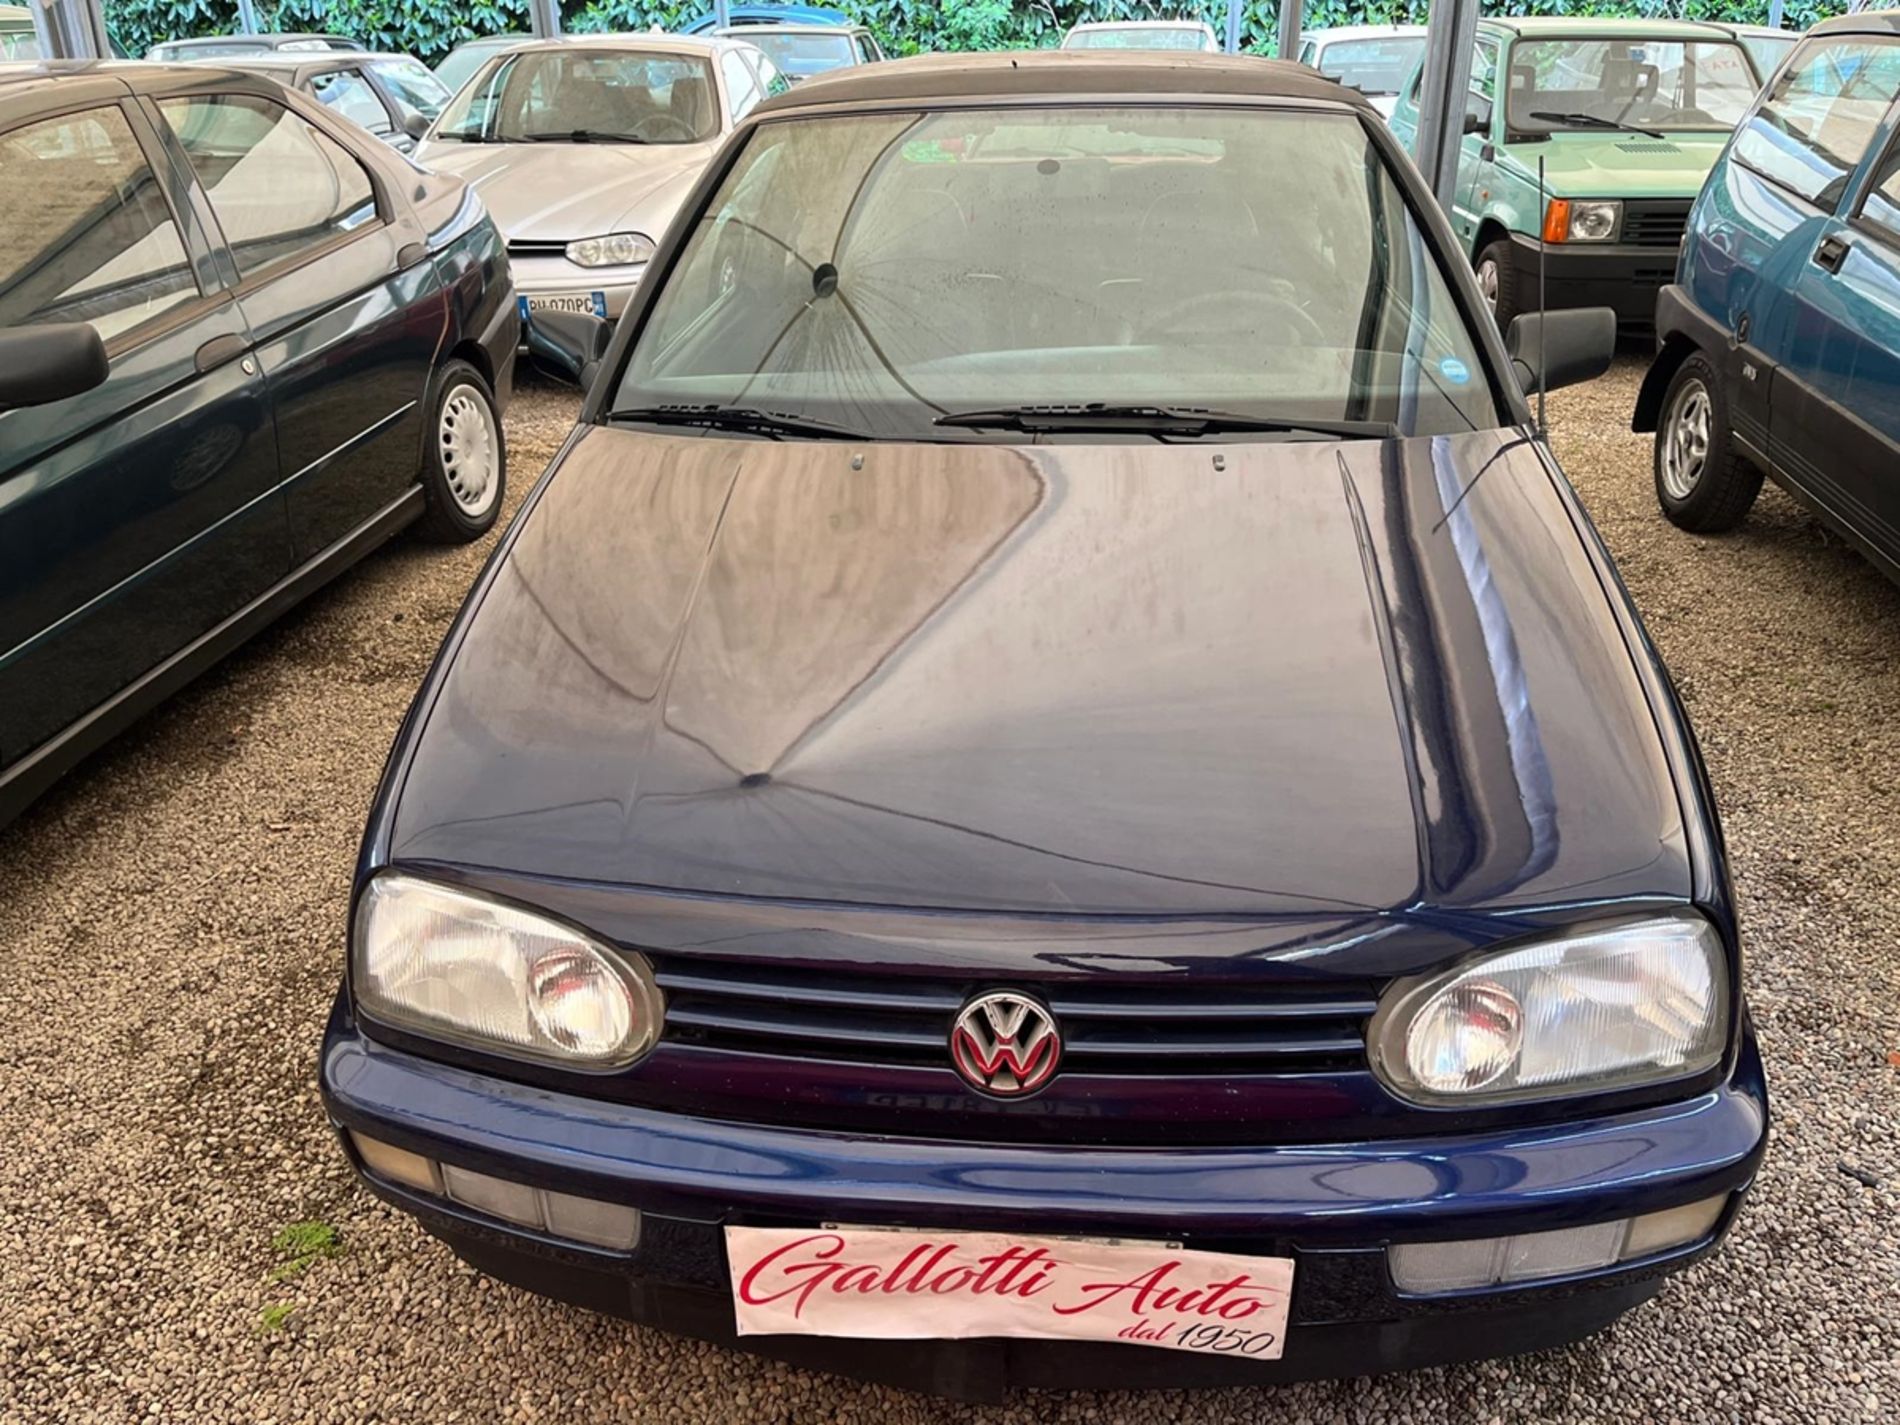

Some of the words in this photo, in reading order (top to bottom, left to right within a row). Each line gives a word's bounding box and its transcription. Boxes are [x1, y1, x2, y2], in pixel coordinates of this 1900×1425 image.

[739, 1235, 1060, 1319] Gallotti
[1053, 1261, 1276, 1320] Auto
[1117, 1318, 1176, 1341] dal
[1177, 1322, 1275, 1354] 1950
